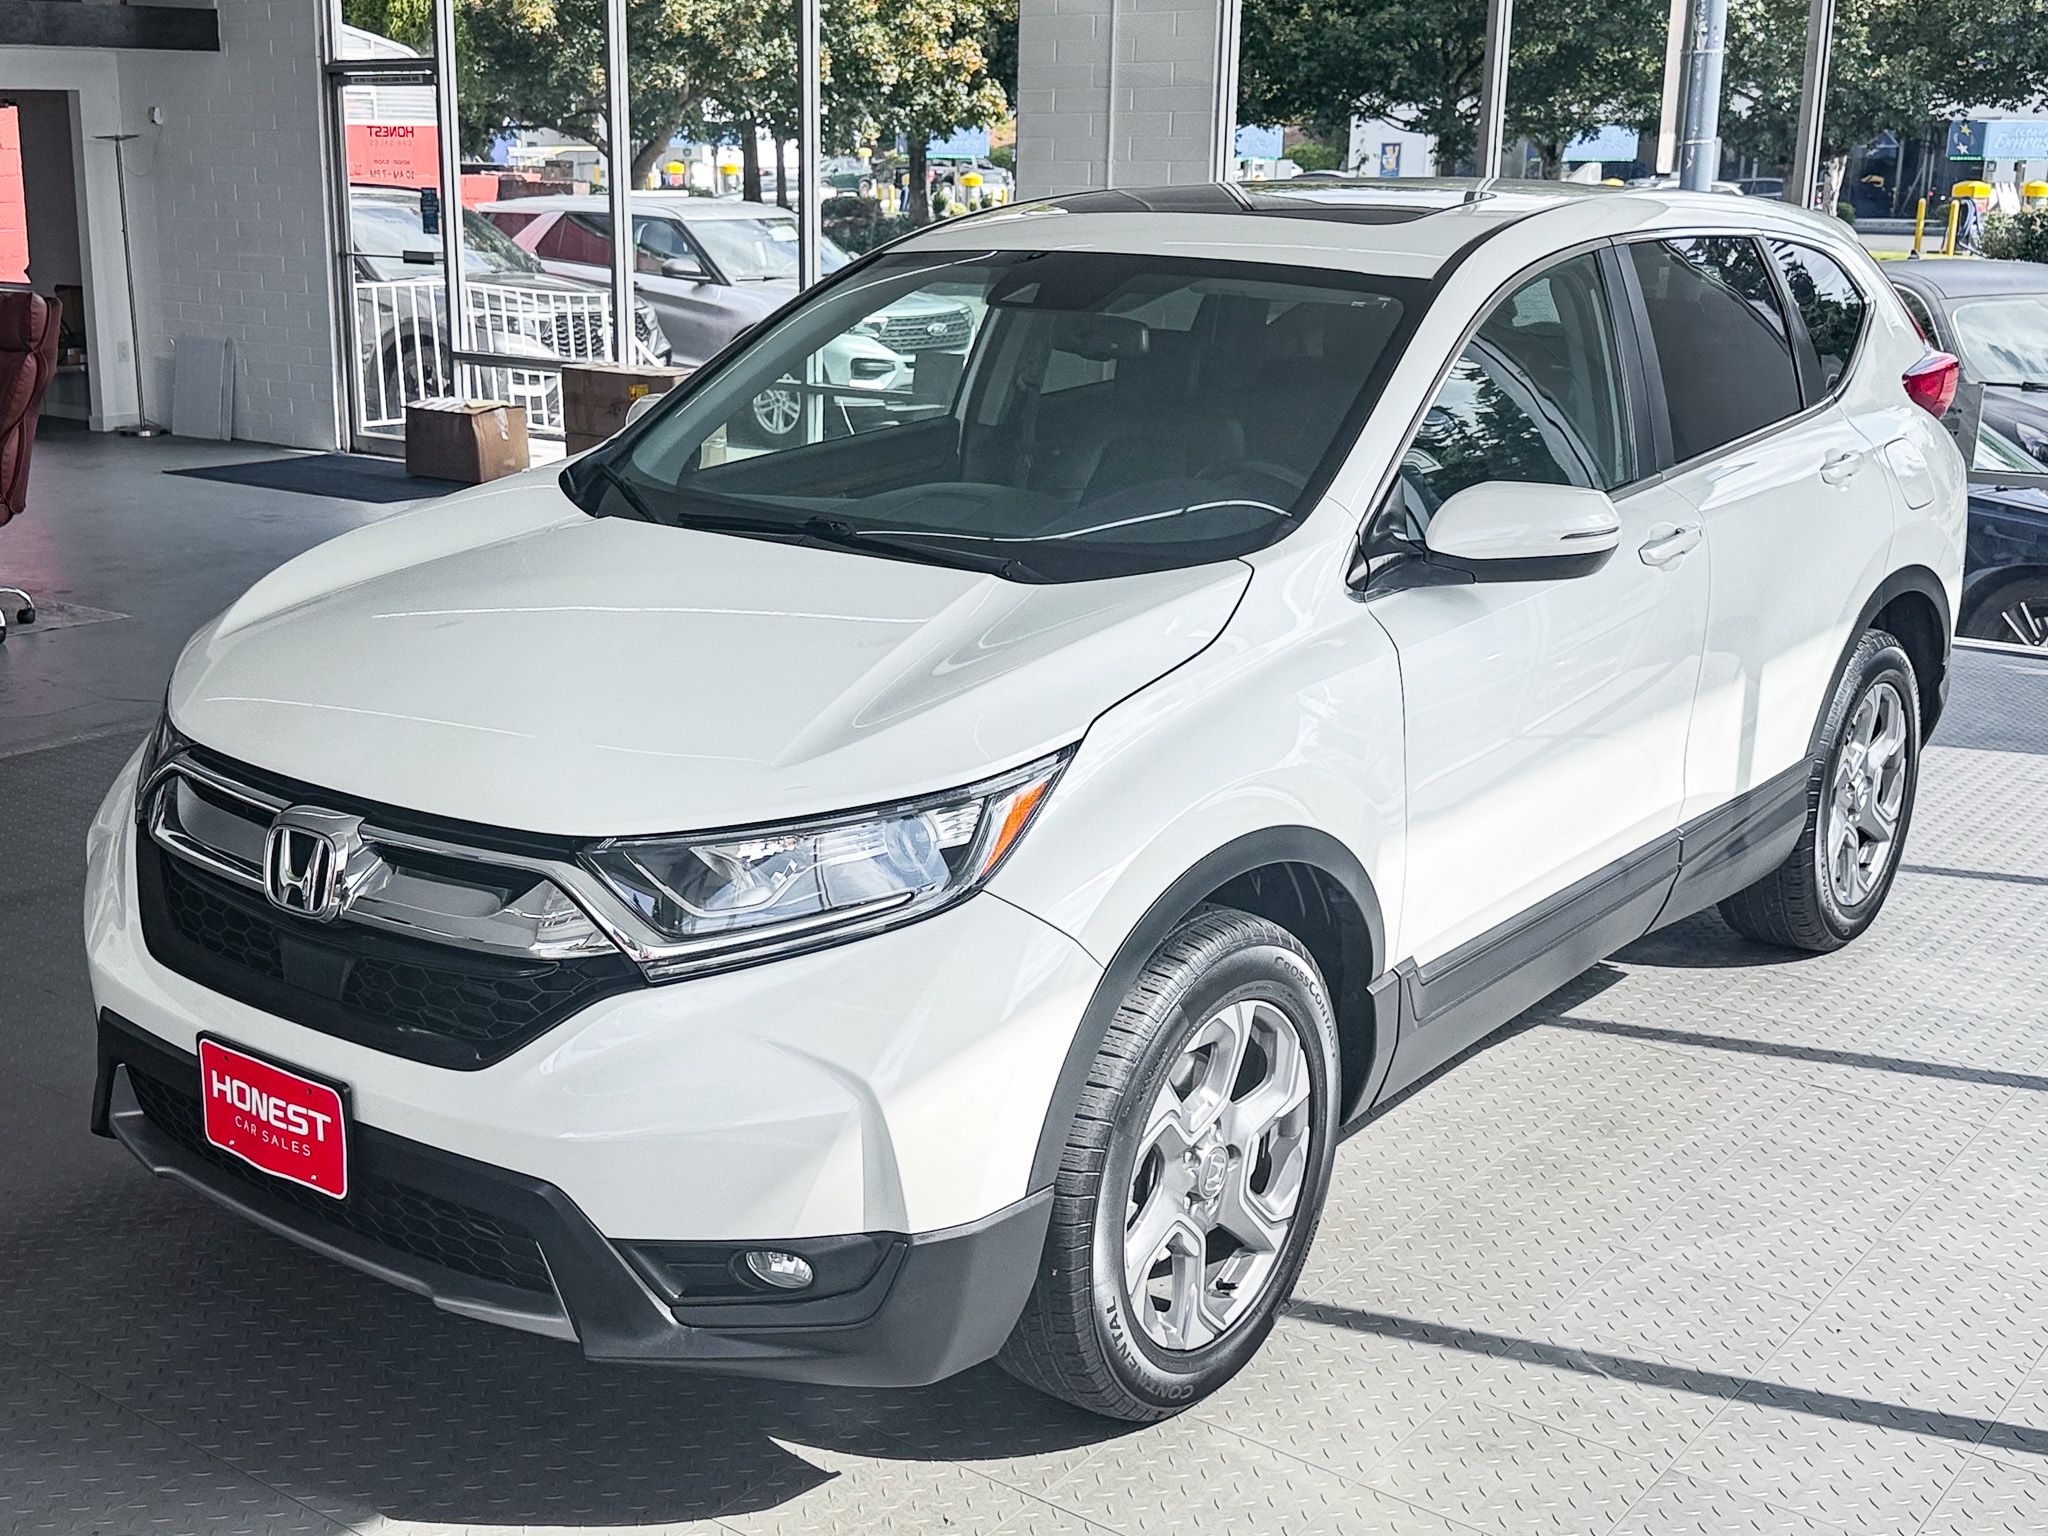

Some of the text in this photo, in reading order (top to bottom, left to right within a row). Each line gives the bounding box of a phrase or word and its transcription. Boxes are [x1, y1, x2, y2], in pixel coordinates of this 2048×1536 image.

[211, 1069, 332, 1142] HONEST
[235, 1115, 311, 1157] CAR SALES
[1106, 1295, 1194, 1400] CONTINENTAL
